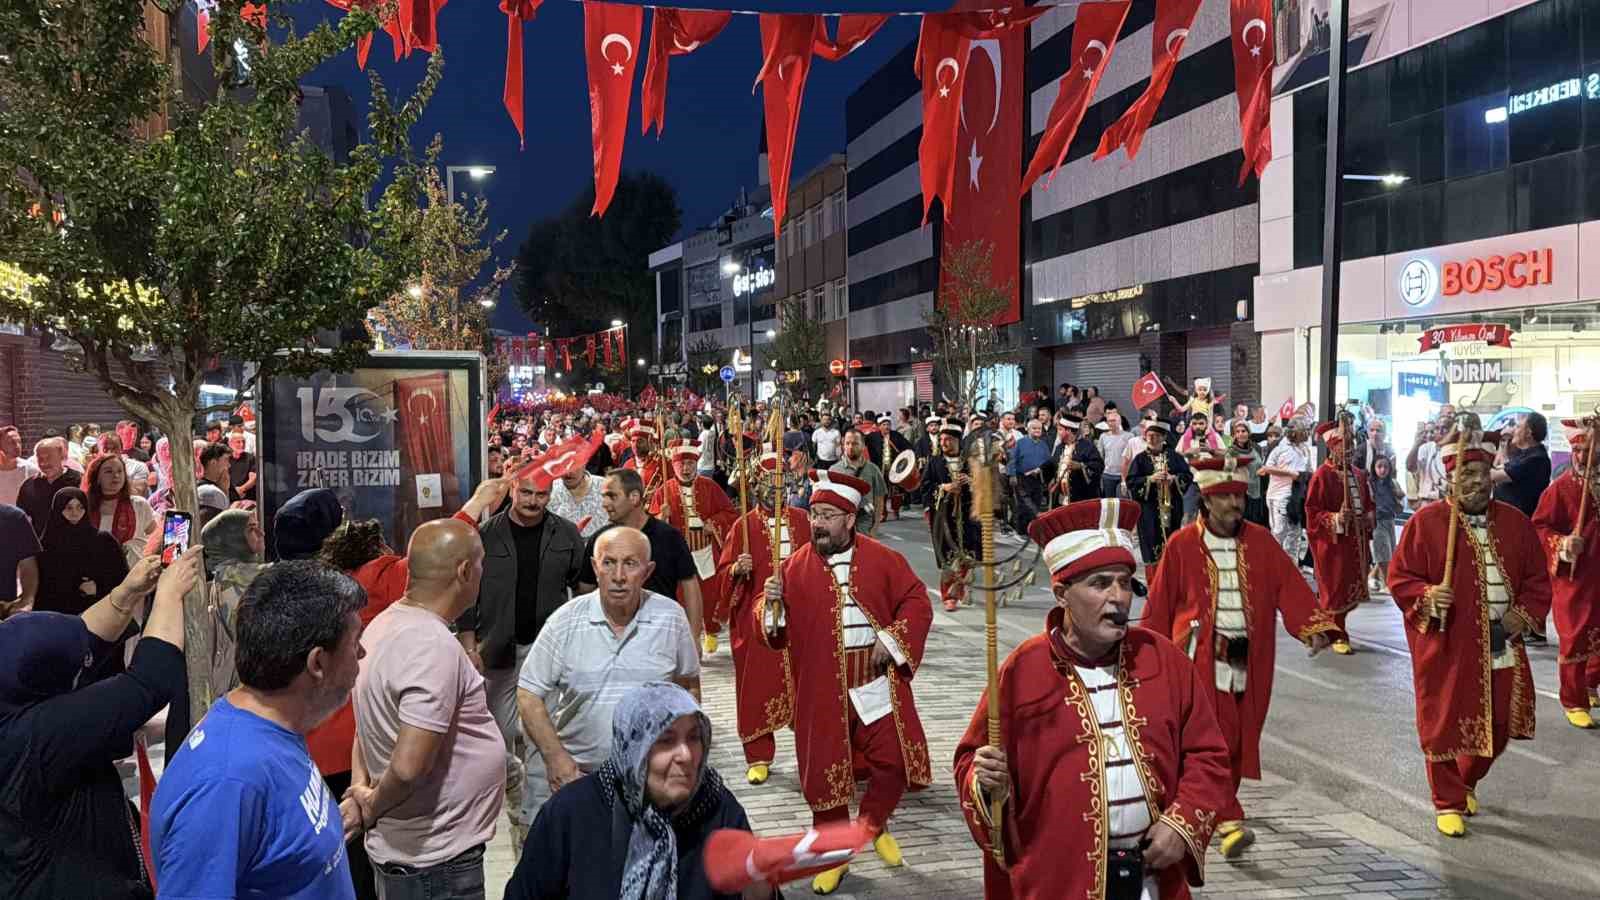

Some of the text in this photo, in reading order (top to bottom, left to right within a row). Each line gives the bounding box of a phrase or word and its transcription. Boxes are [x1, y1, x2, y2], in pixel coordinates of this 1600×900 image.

[1443, 248, 1553, 296] BOSCH
[296, 387, 360, 443] 15
[296, 450, 400, 469] İRADE BİZİM
[353, 469, 400, 486] BİZİM
